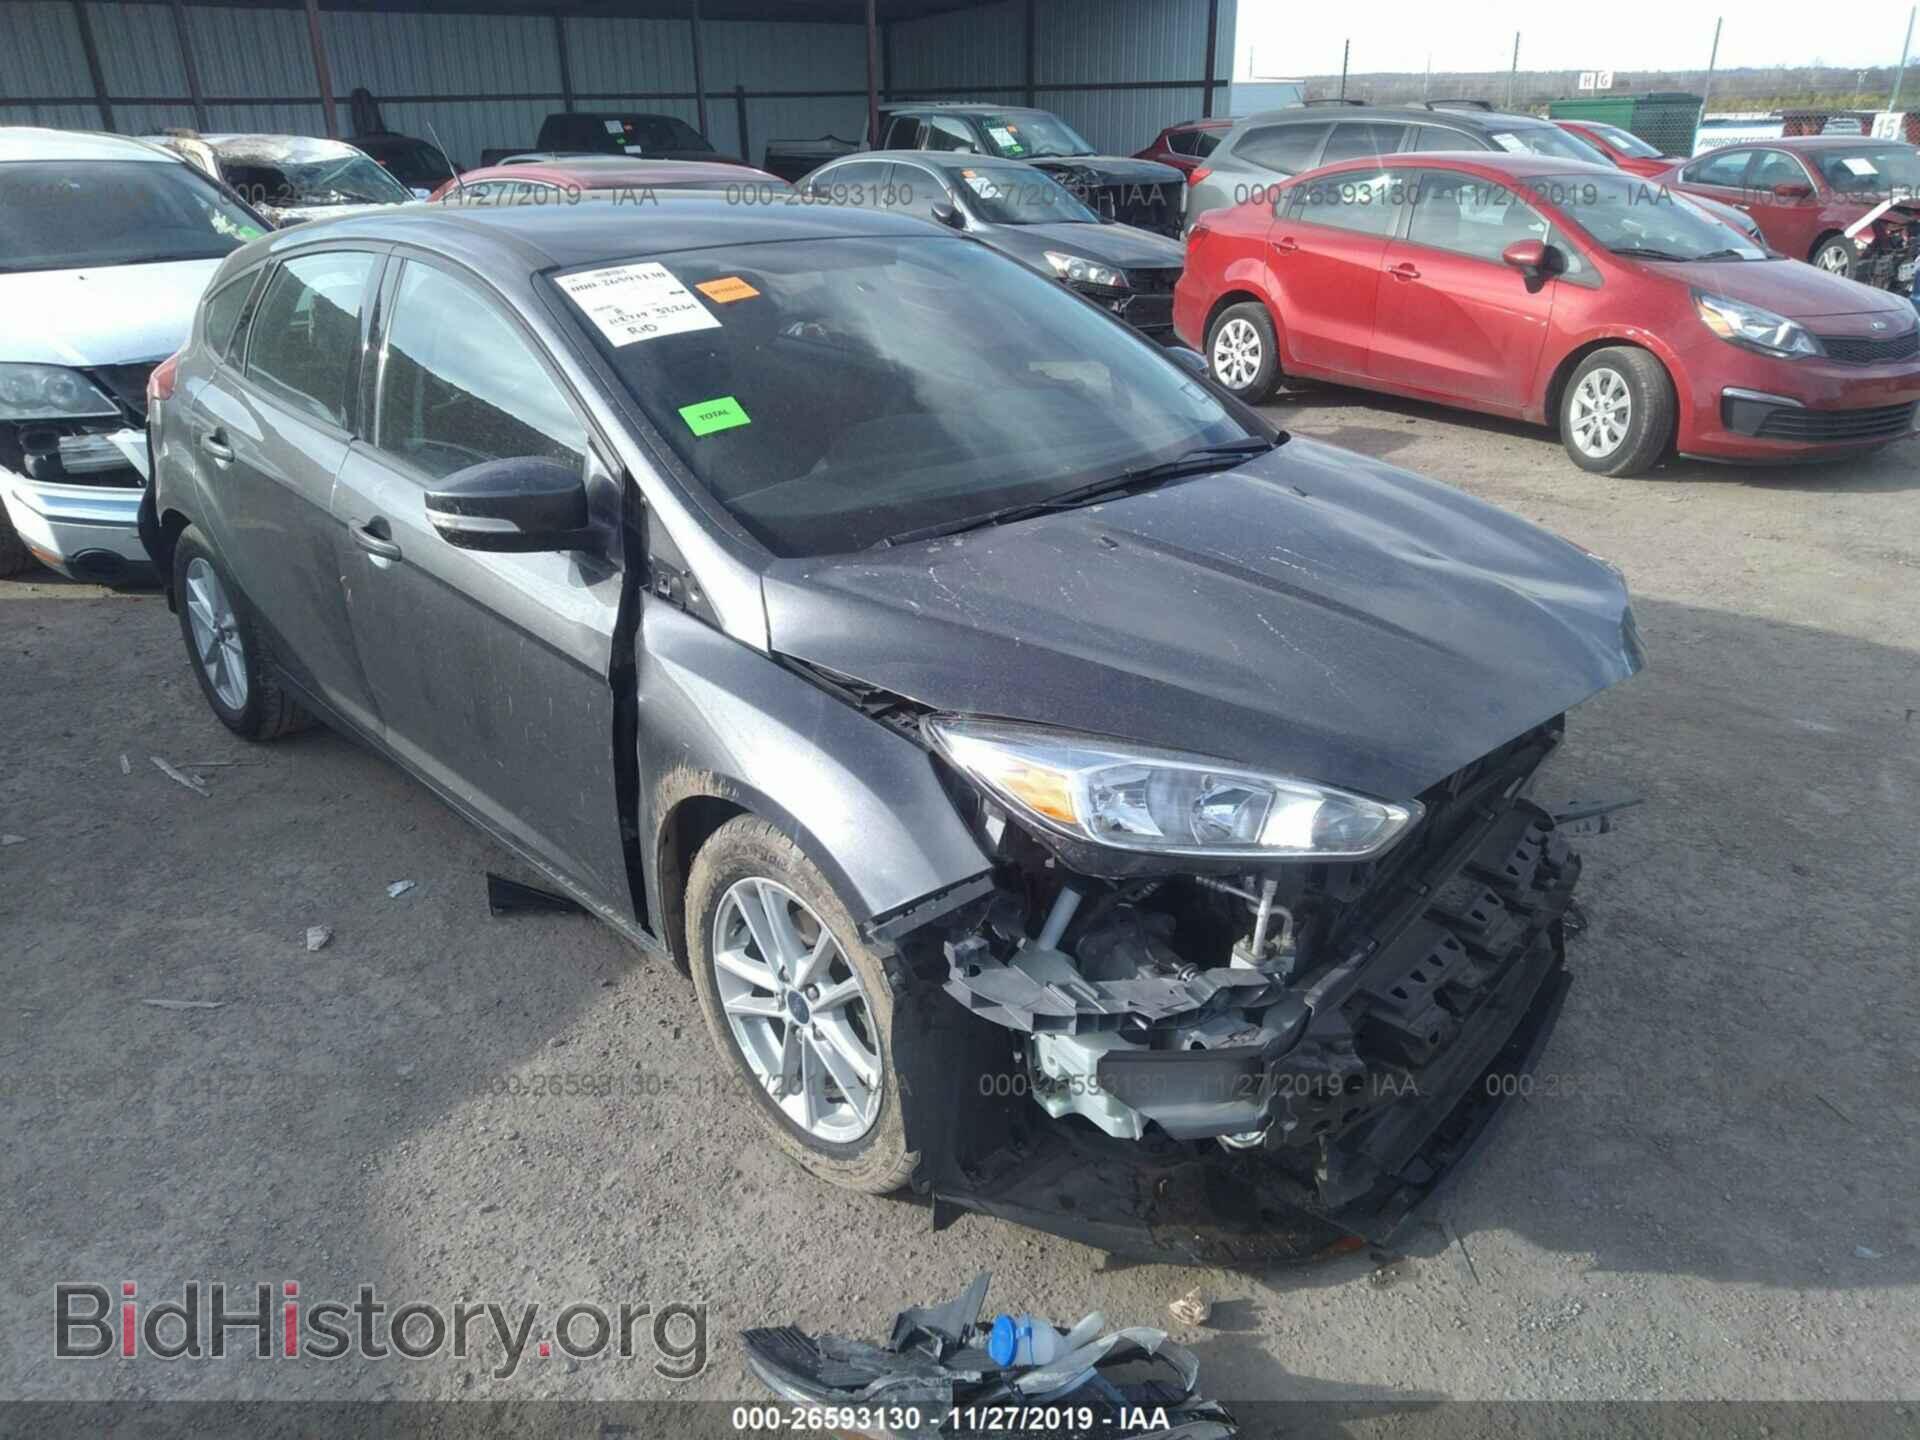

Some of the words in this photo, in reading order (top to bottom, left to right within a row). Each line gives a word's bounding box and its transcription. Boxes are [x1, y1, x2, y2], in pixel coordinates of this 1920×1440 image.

[1584, 74, 1592, 87] H
[1600, 73, 1608, 87] G
[1878, 118, 1896, 138] 15
[699, 409, 731, 422] TOTAL
